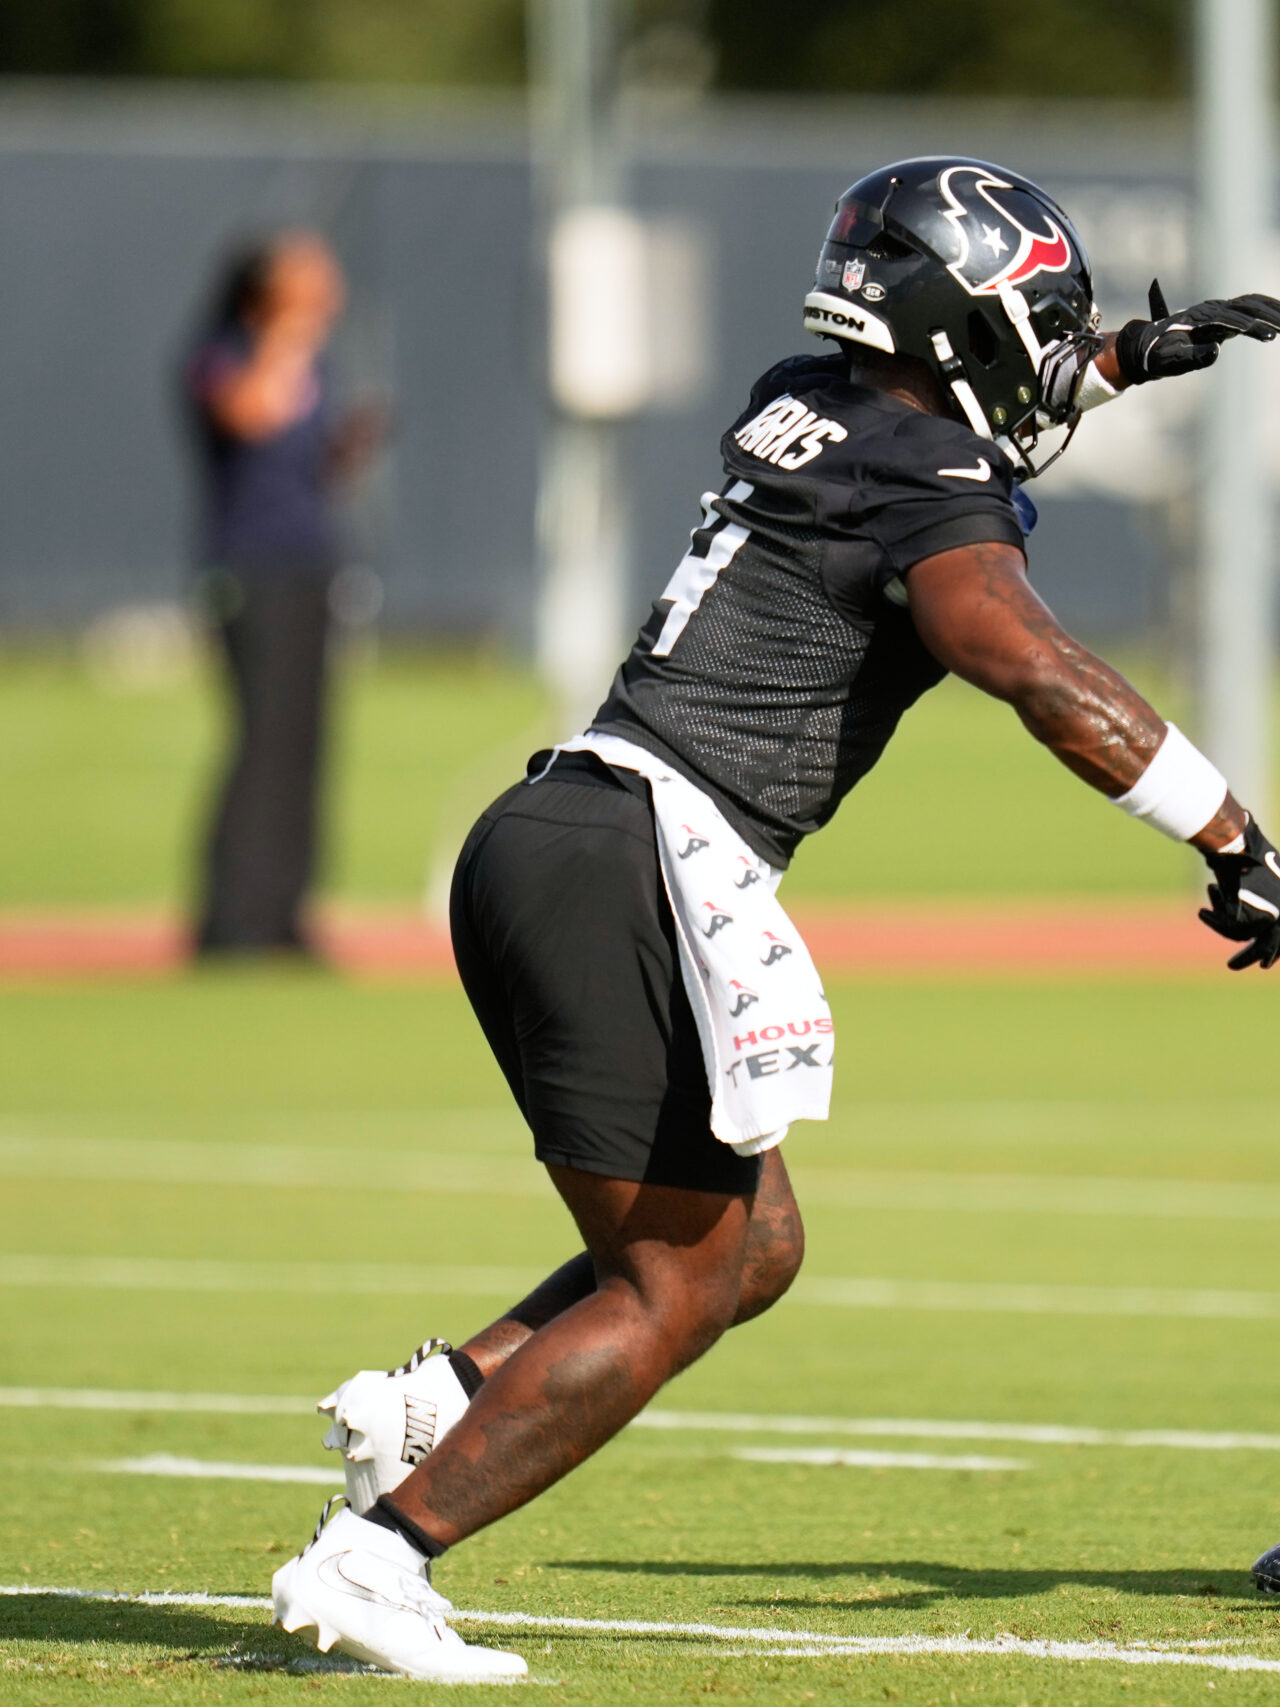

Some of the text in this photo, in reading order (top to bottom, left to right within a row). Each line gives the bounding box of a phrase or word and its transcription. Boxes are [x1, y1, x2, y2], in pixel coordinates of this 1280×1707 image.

[803, 306, 865, 332] STON
[733, 1018, 834, 1051] HOUS
[726, 1043, 833, 1088] TEX
